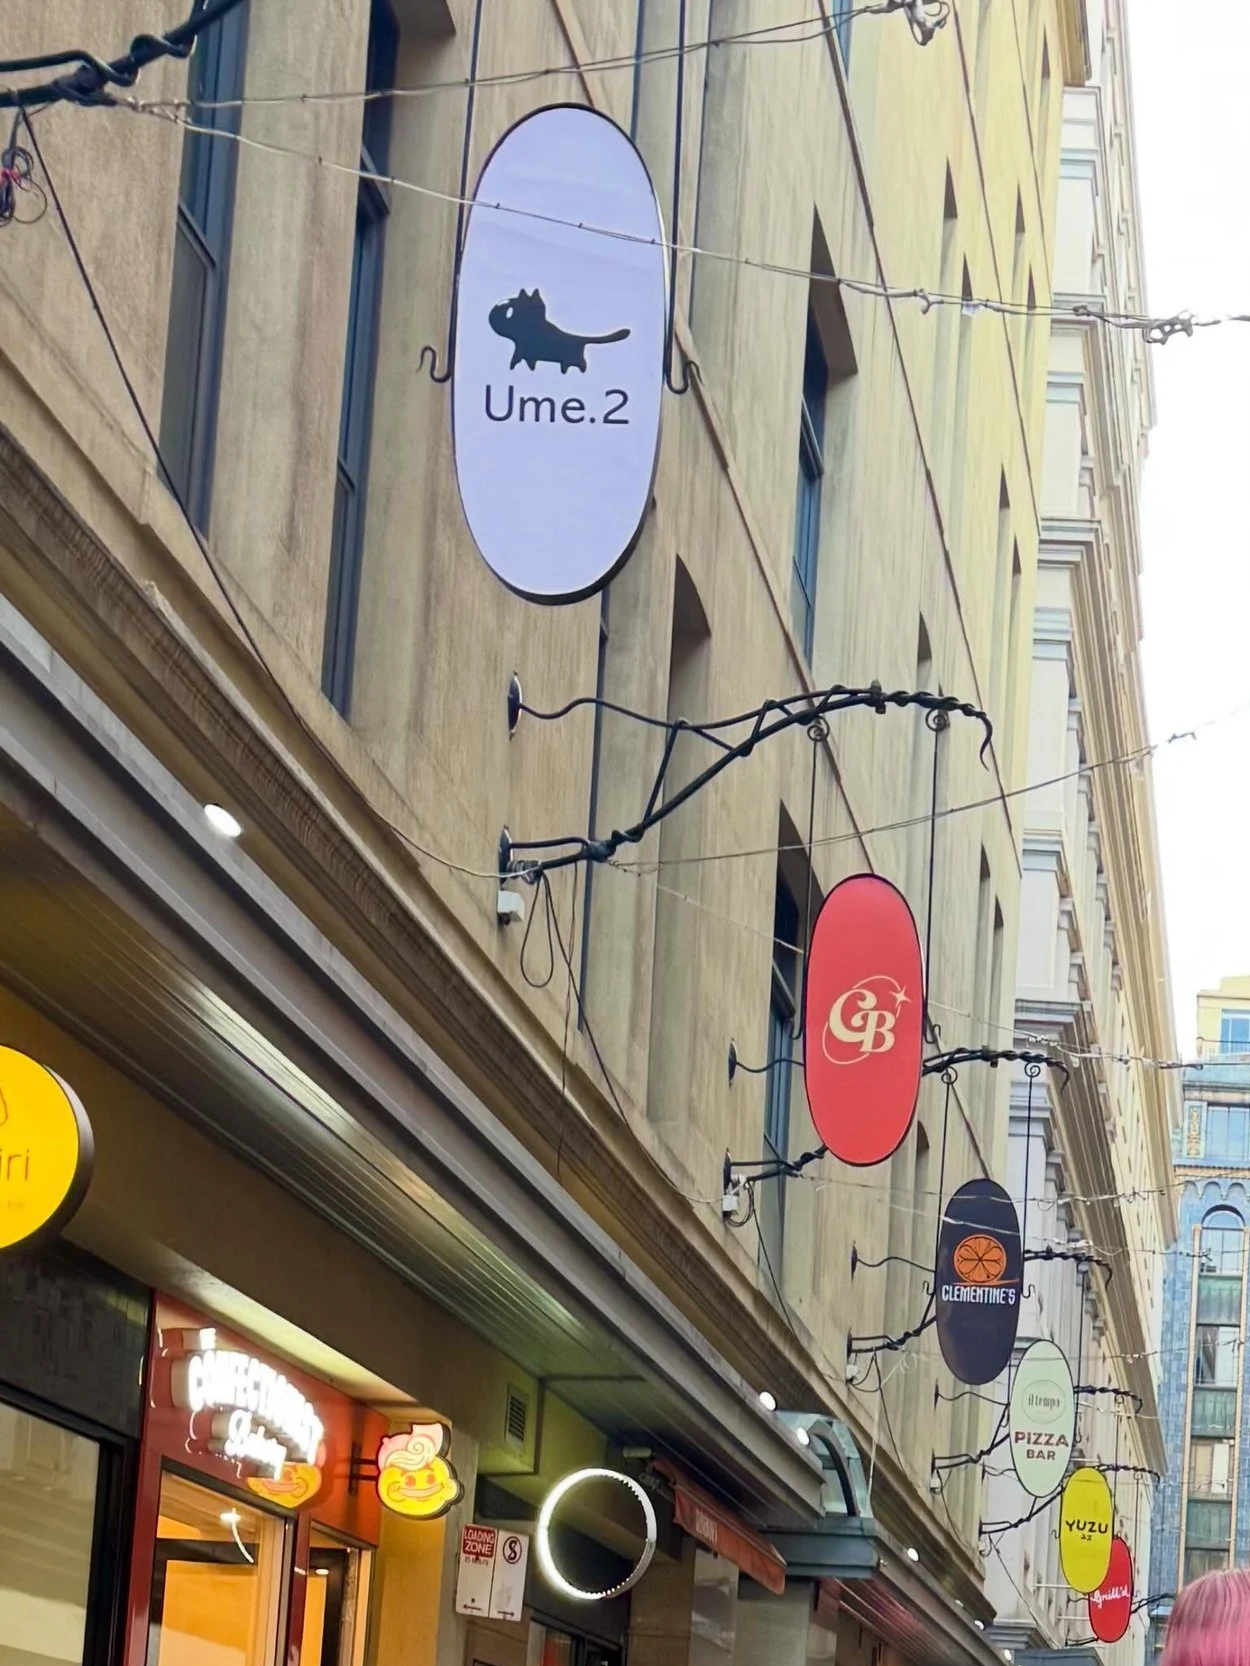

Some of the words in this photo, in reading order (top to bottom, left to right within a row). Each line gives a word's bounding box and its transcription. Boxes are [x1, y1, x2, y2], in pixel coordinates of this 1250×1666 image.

[485, 384, 630, 425] Ume.2
[941, 1284, 1017, 1305] CLEMENTINE'S
[1014, 1431, 1069, 1448] PIZZA
[1026, 1449, 1057, 1461] BAR
[1065, 1519, 1109, 1535] YUZU
[464, 1529, 495, 1544] LOADING
[464, 1540, 493, 1555] ZONE
